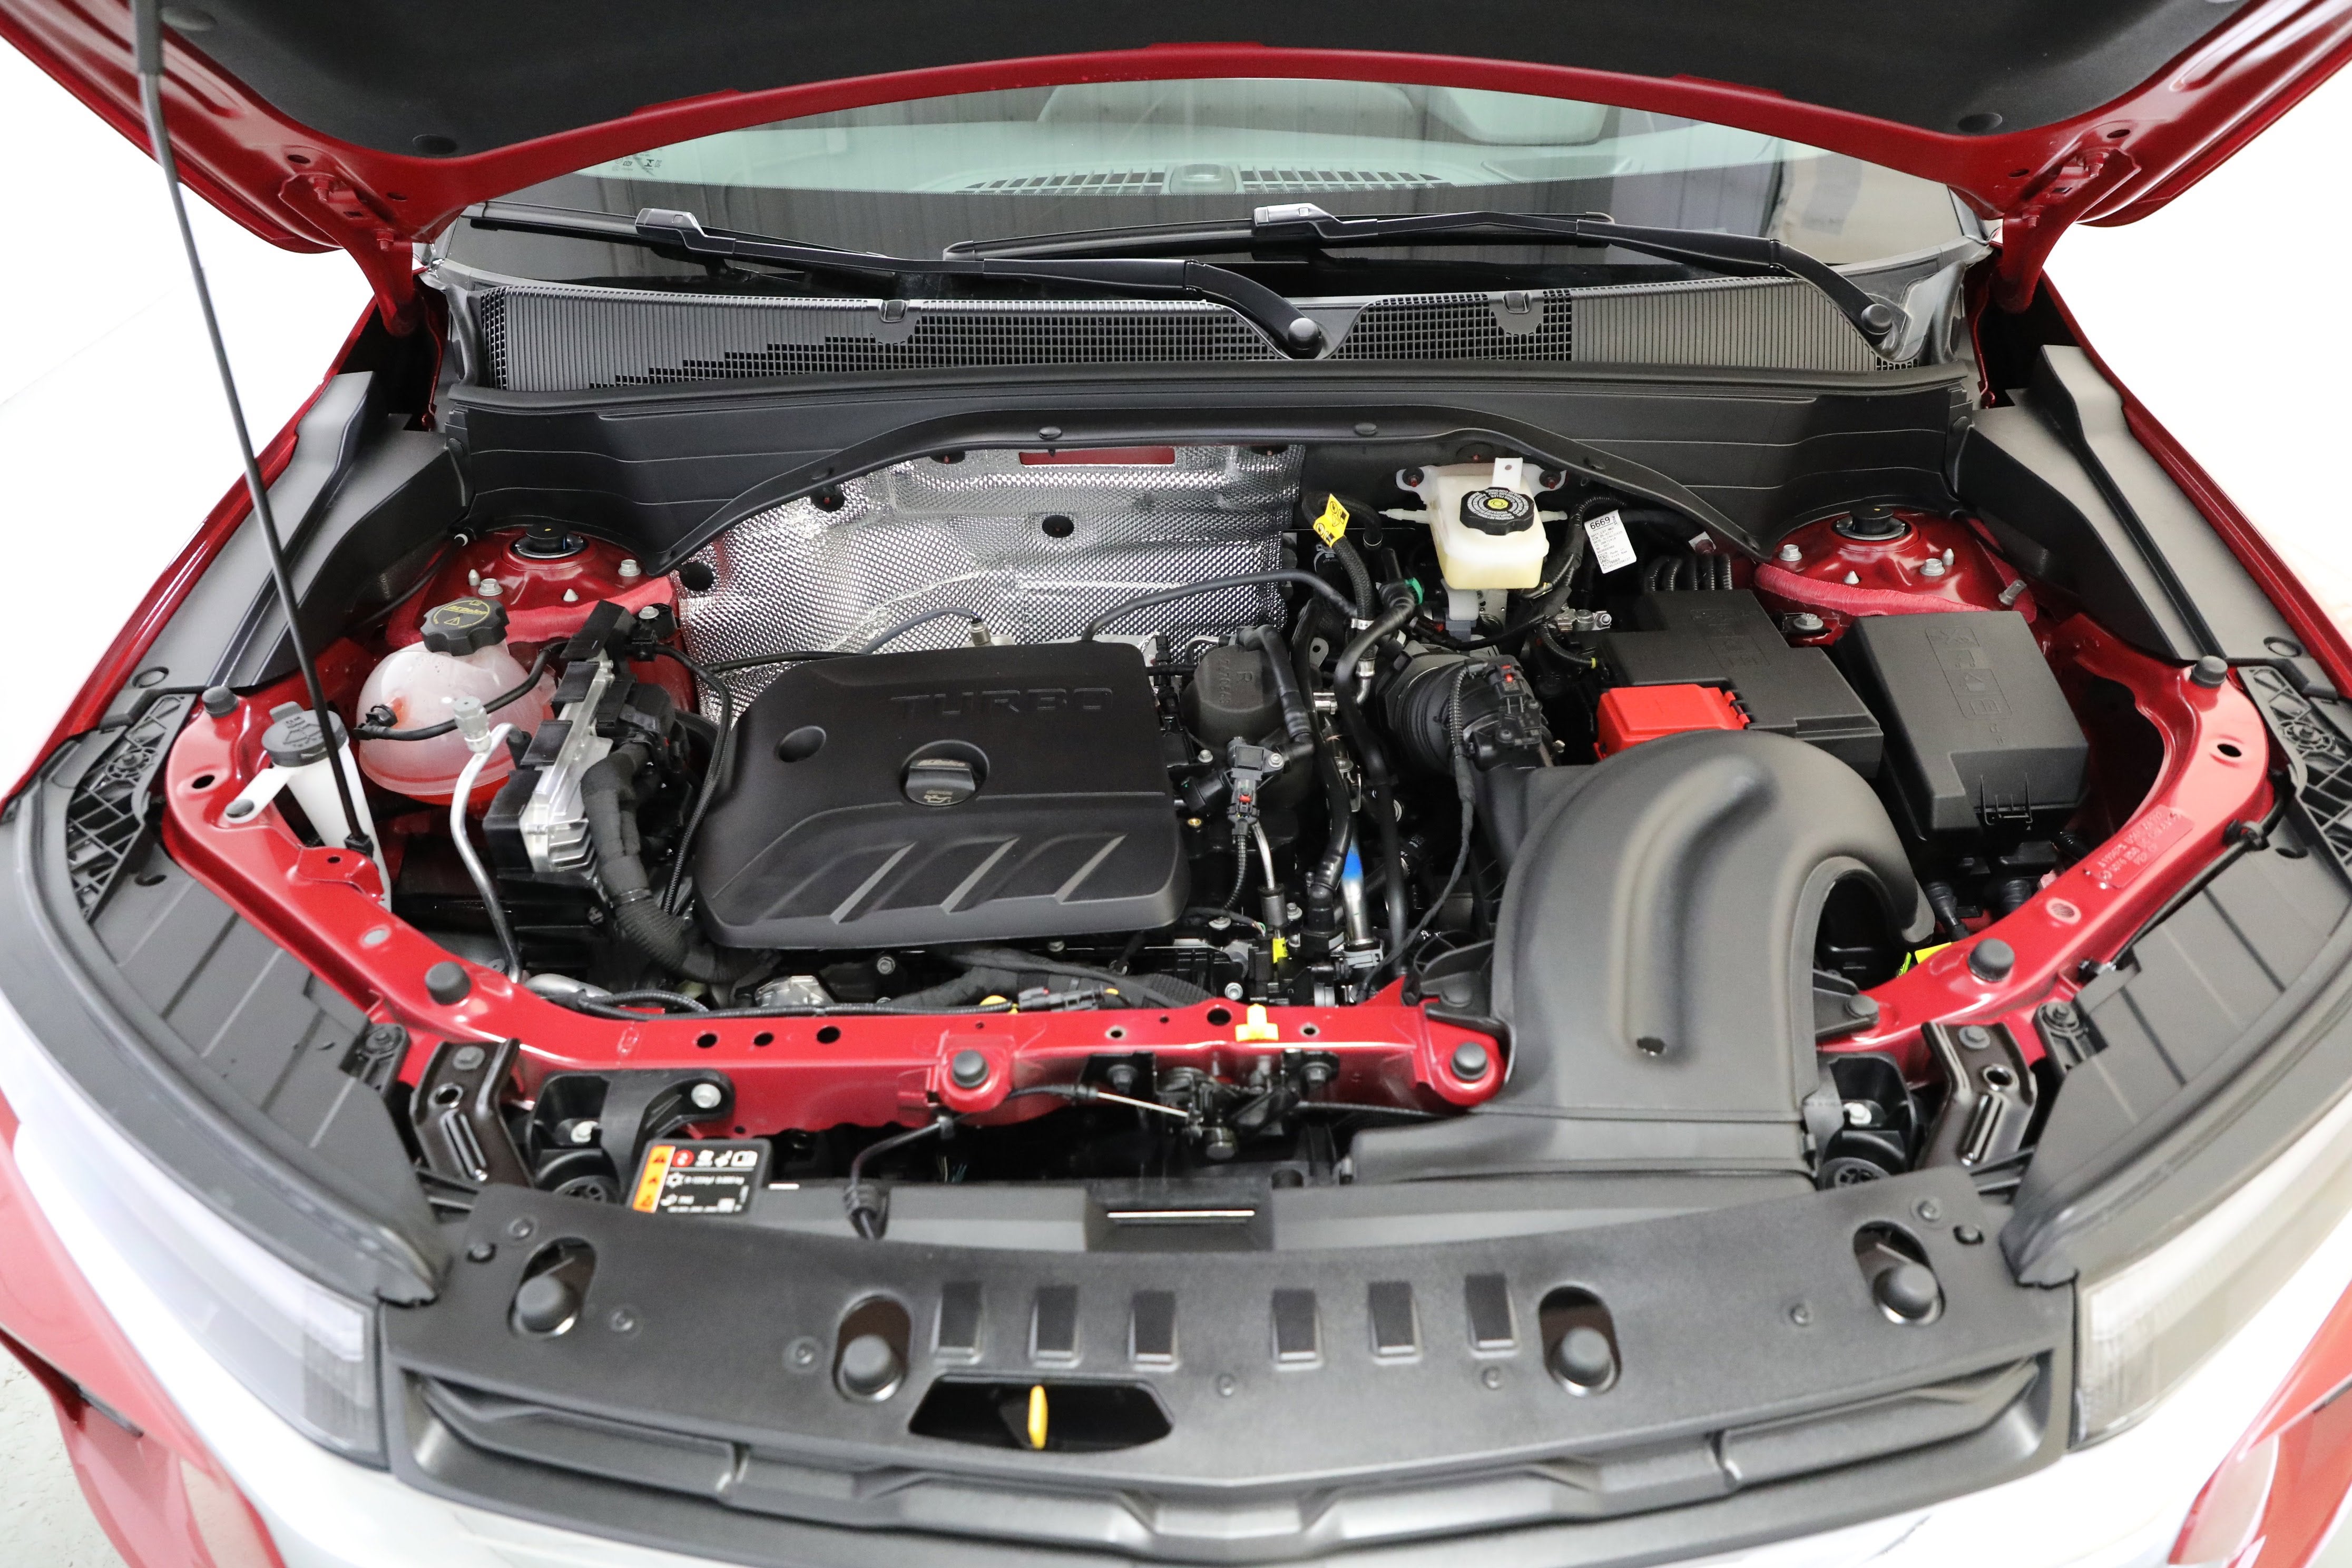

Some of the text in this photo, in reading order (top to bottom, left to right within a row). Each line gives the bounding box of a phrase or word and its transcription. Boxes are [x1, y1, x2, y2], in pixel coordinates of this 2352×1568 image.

[1590, 516, 1610, 530] 6669
[446, 605, 487, 615] ACDelco
[890, 687, 1113, 716] TURBO
